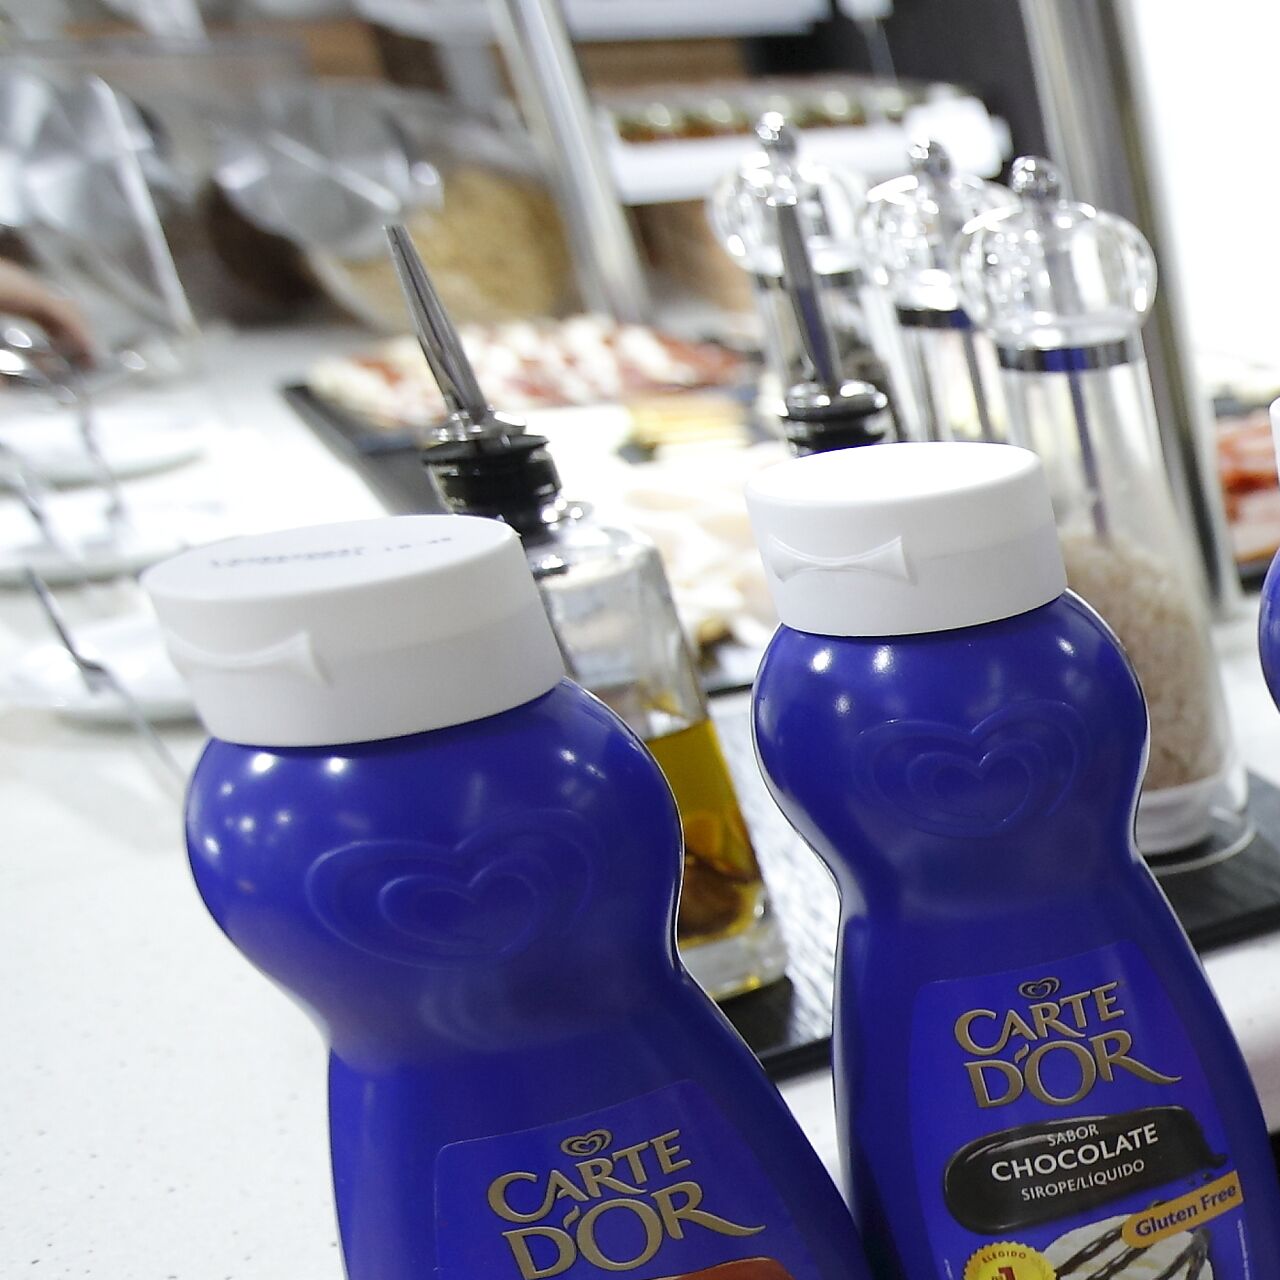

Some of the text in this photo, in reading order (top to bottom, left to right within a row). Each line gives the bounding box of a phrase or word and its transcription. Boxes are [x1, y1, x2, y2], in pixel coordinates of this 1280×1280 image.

[953, 980, 1125, 1056] CARTE
[963, 1028, 1183, 1109] D'OR
[991, 1123, 1159, 1182] CHOCOLATE
[1047, 1123, 1099, 1147] SABOR
[487, 1129, 692, 1224] CARTE
[1021, 1158, 1145, 1202] SIROPE/LÍQUIDO
[1135, 1183, 1237, 1238] Gluten Free
[982, 1250, 1027, 1264] ELEGIDO
